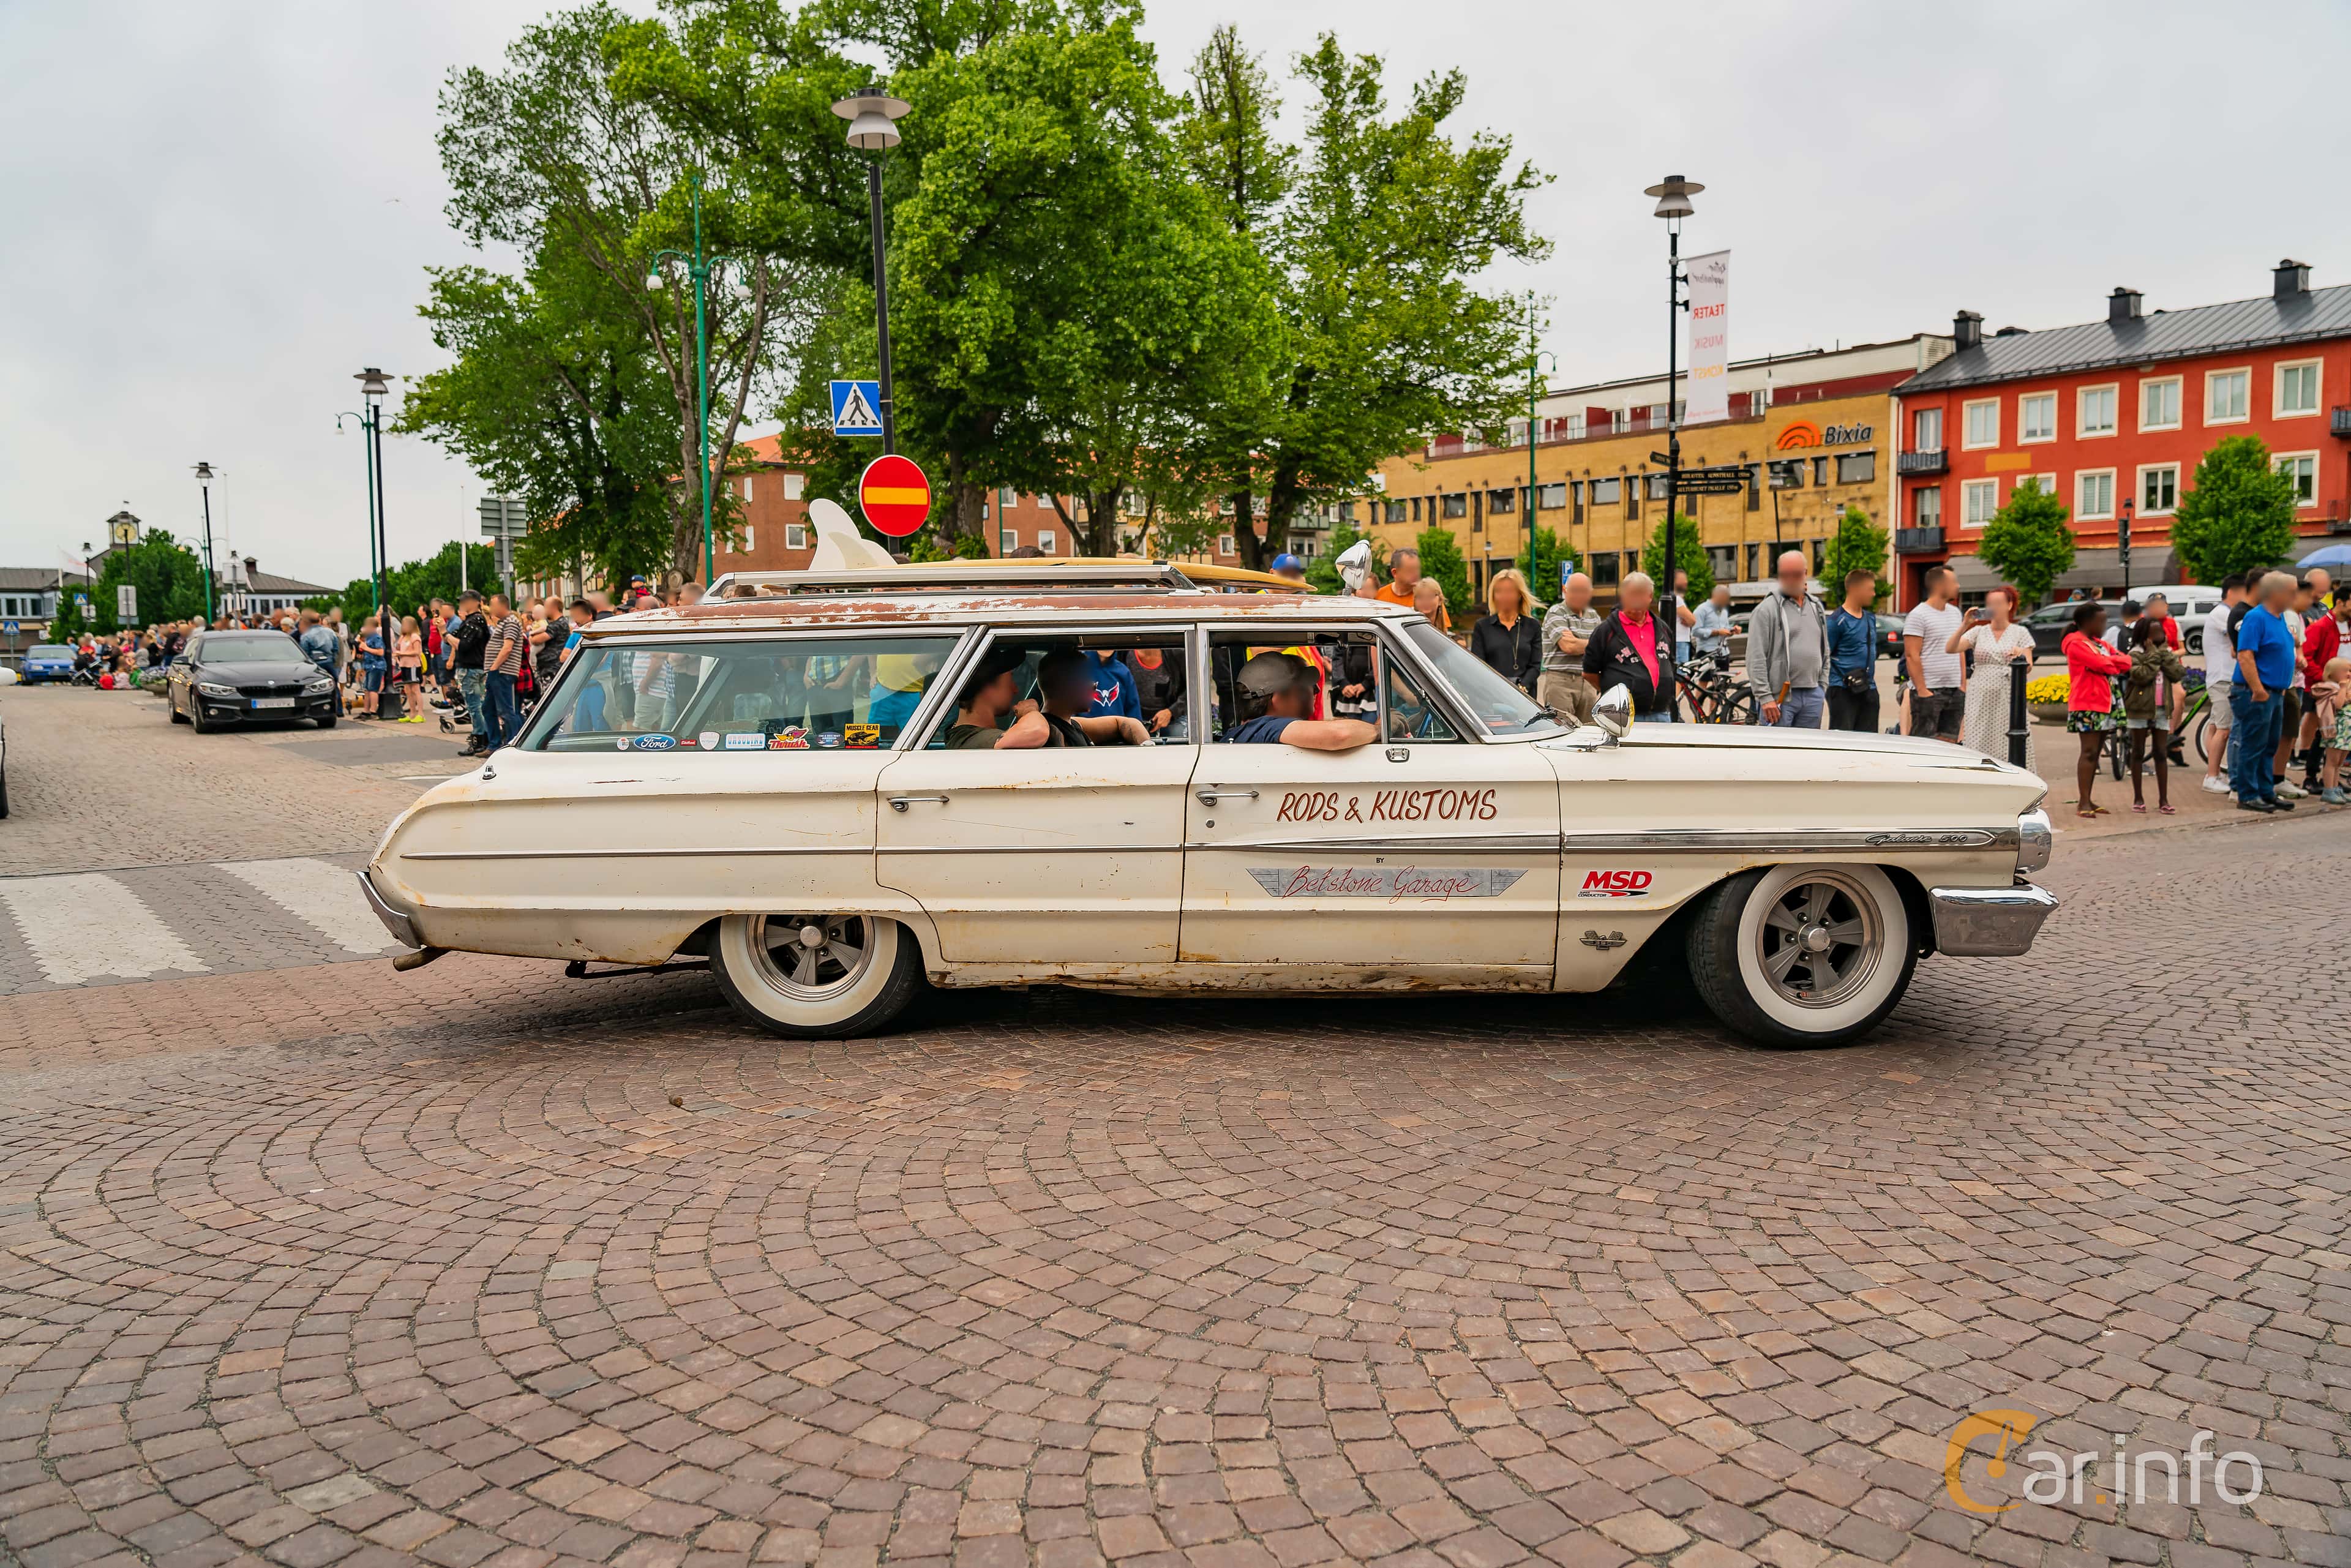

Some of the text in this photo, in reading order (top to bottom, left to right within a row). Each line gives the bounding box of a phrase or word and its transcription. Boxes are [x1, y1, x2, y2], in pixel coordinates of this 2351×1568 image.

[1823, 422, 1873, 446] Bixia
[1565, 563, 1571, 574] P
[640, 736, 668, 748] Ford
[769, 740, 809, 749] Thrush
[1276, 789, 1498, 823] RODS & KUSTOMS
[1281, 865, 1485, 904] Betstone Garage
[1581, 871, 1652, 889] MSD
